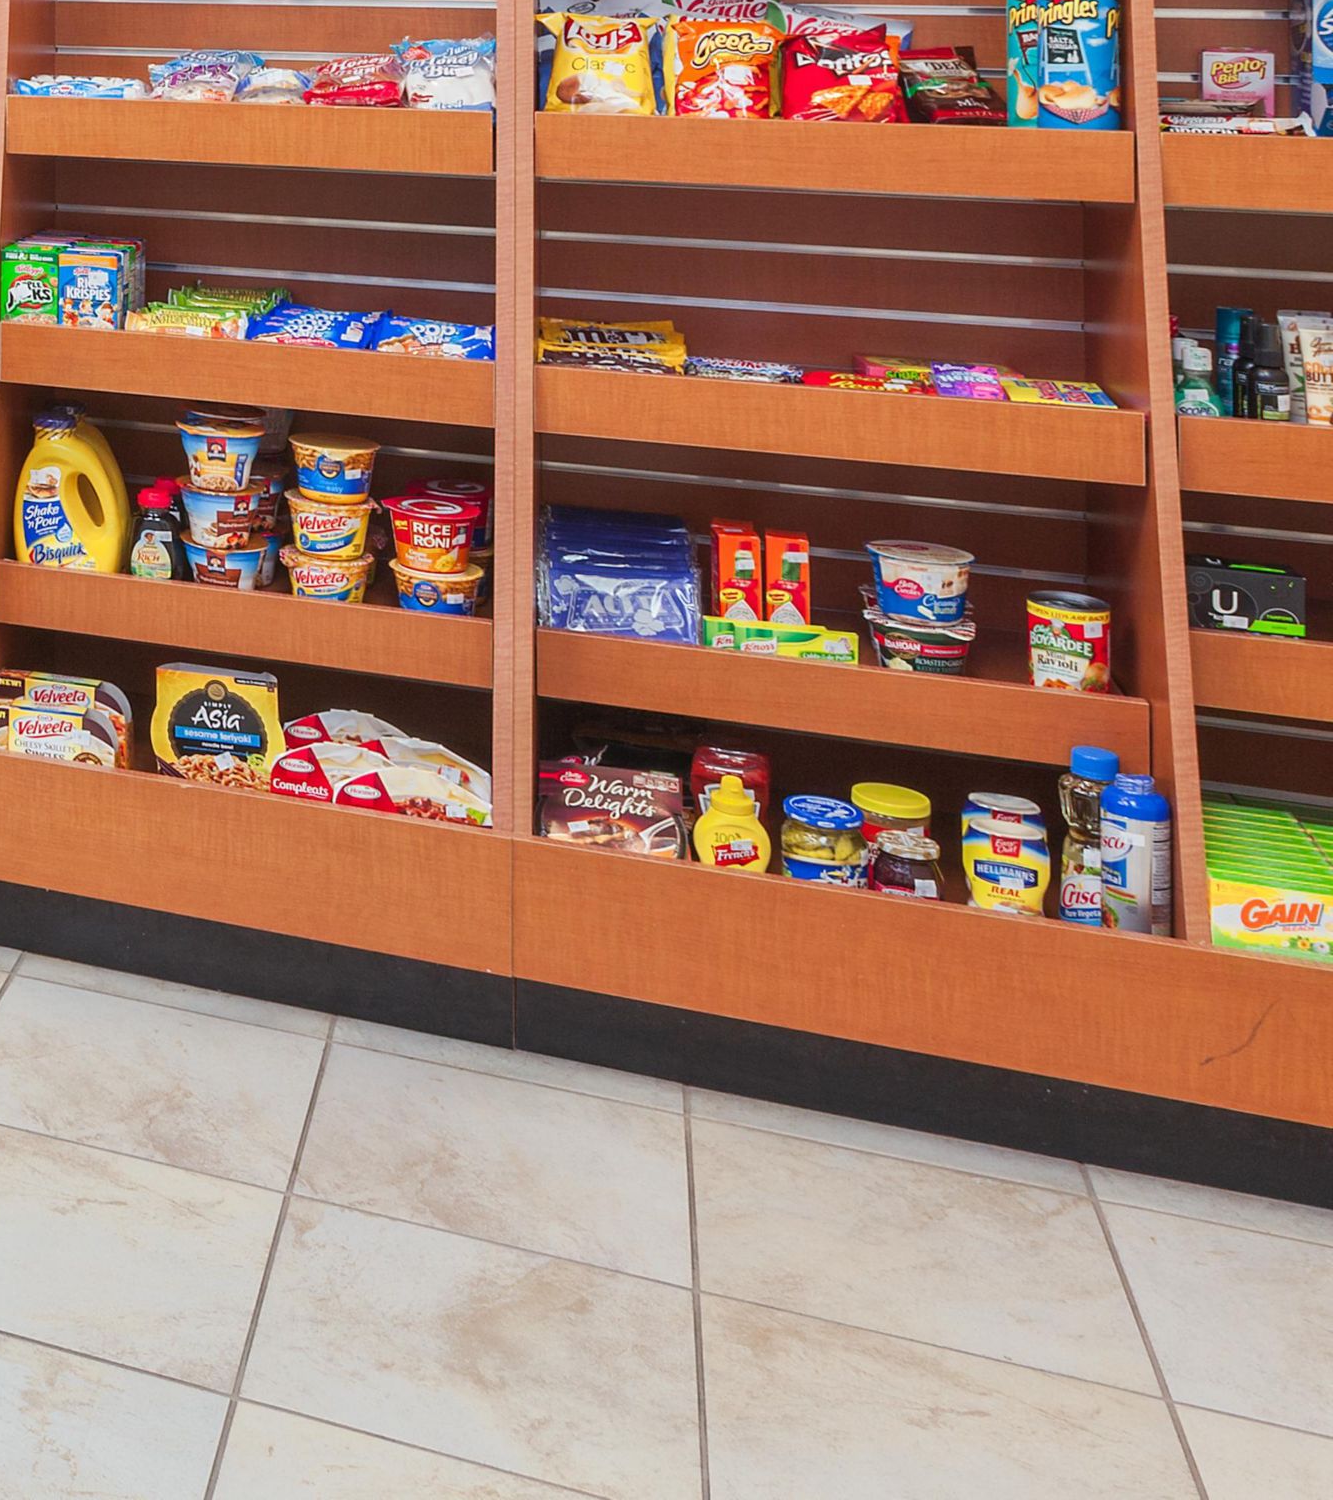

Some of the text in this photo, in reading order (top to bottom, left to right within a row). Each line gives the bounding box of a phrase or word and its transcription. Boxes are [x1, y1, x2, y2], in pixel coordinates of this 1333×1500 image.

[691, 30, 774, 67] Cheetos
[330, 55, 390, 75] Honey
[570, 56, 637, 73] Clasc
[66, 286, 111, 300] KRISPIES
[24, 503, 60, 521] Shake
[34, 514, 63, 529] Pour
[412, 522, 451, 536] RICE
[413, 535, 450, 550] RONI
[33, 543, 87, 564] Bisquick
[293, 570, 345, 587] Velveeta
[1212, 589, 1238, 615] U
[741, 641, 777, 653] Knorr
[1036, 655, 1079, 674] Ravioli
[33, 690, 87, 706] Velveeta
[203, 700, 232, 709] SIMPLY
[190, 704, 242, 731] Asia
[17, 720, 73, 737] Velveeta
[184, 728, 219, 740] sesame
[14, 737, 44, 750] CHEESY
[271, 778, 329, 798] Compleats
[587, 774, 653, 799] Warm
[563, 787, 657, 820] Delights
[975, 862, 1036, 883] HELLMANN'S
[990, 885, 1021, 899] REAL
[1062, 883, 1101, 908] Crisc
[1240, 898, 1323, 932] GAIN
